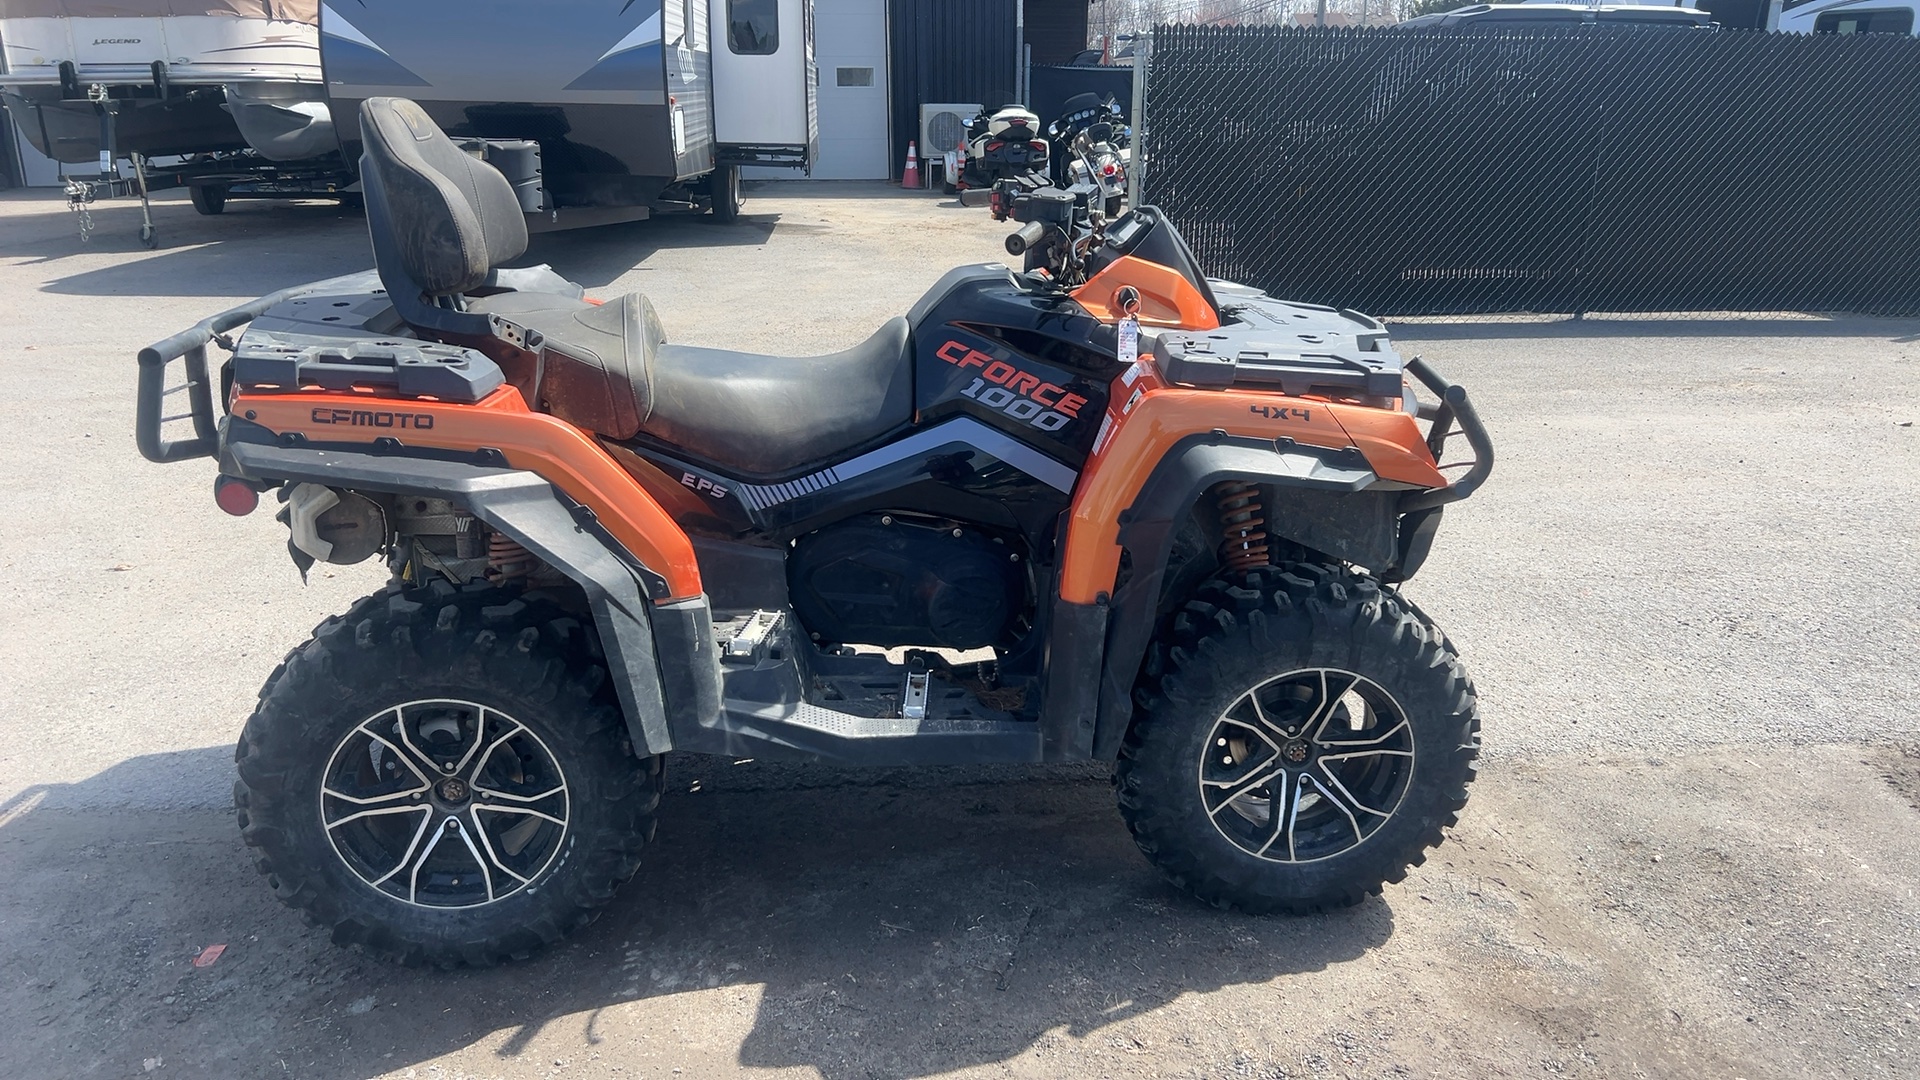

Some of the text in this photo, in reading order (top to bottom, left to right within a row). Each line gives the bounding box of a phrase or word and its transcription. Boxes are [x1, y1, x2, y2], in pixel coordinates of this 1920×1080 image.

[92, 38, 142, 46] LEGEND
[935, 340, 1089, 419] CFORCE
[960, 377, 1071, 431] 1000
[1250, 405, 1310, 422] 4X4
[311, 407, 434, 430] CFMOTO
[681, 472, 729, 499] EPS
